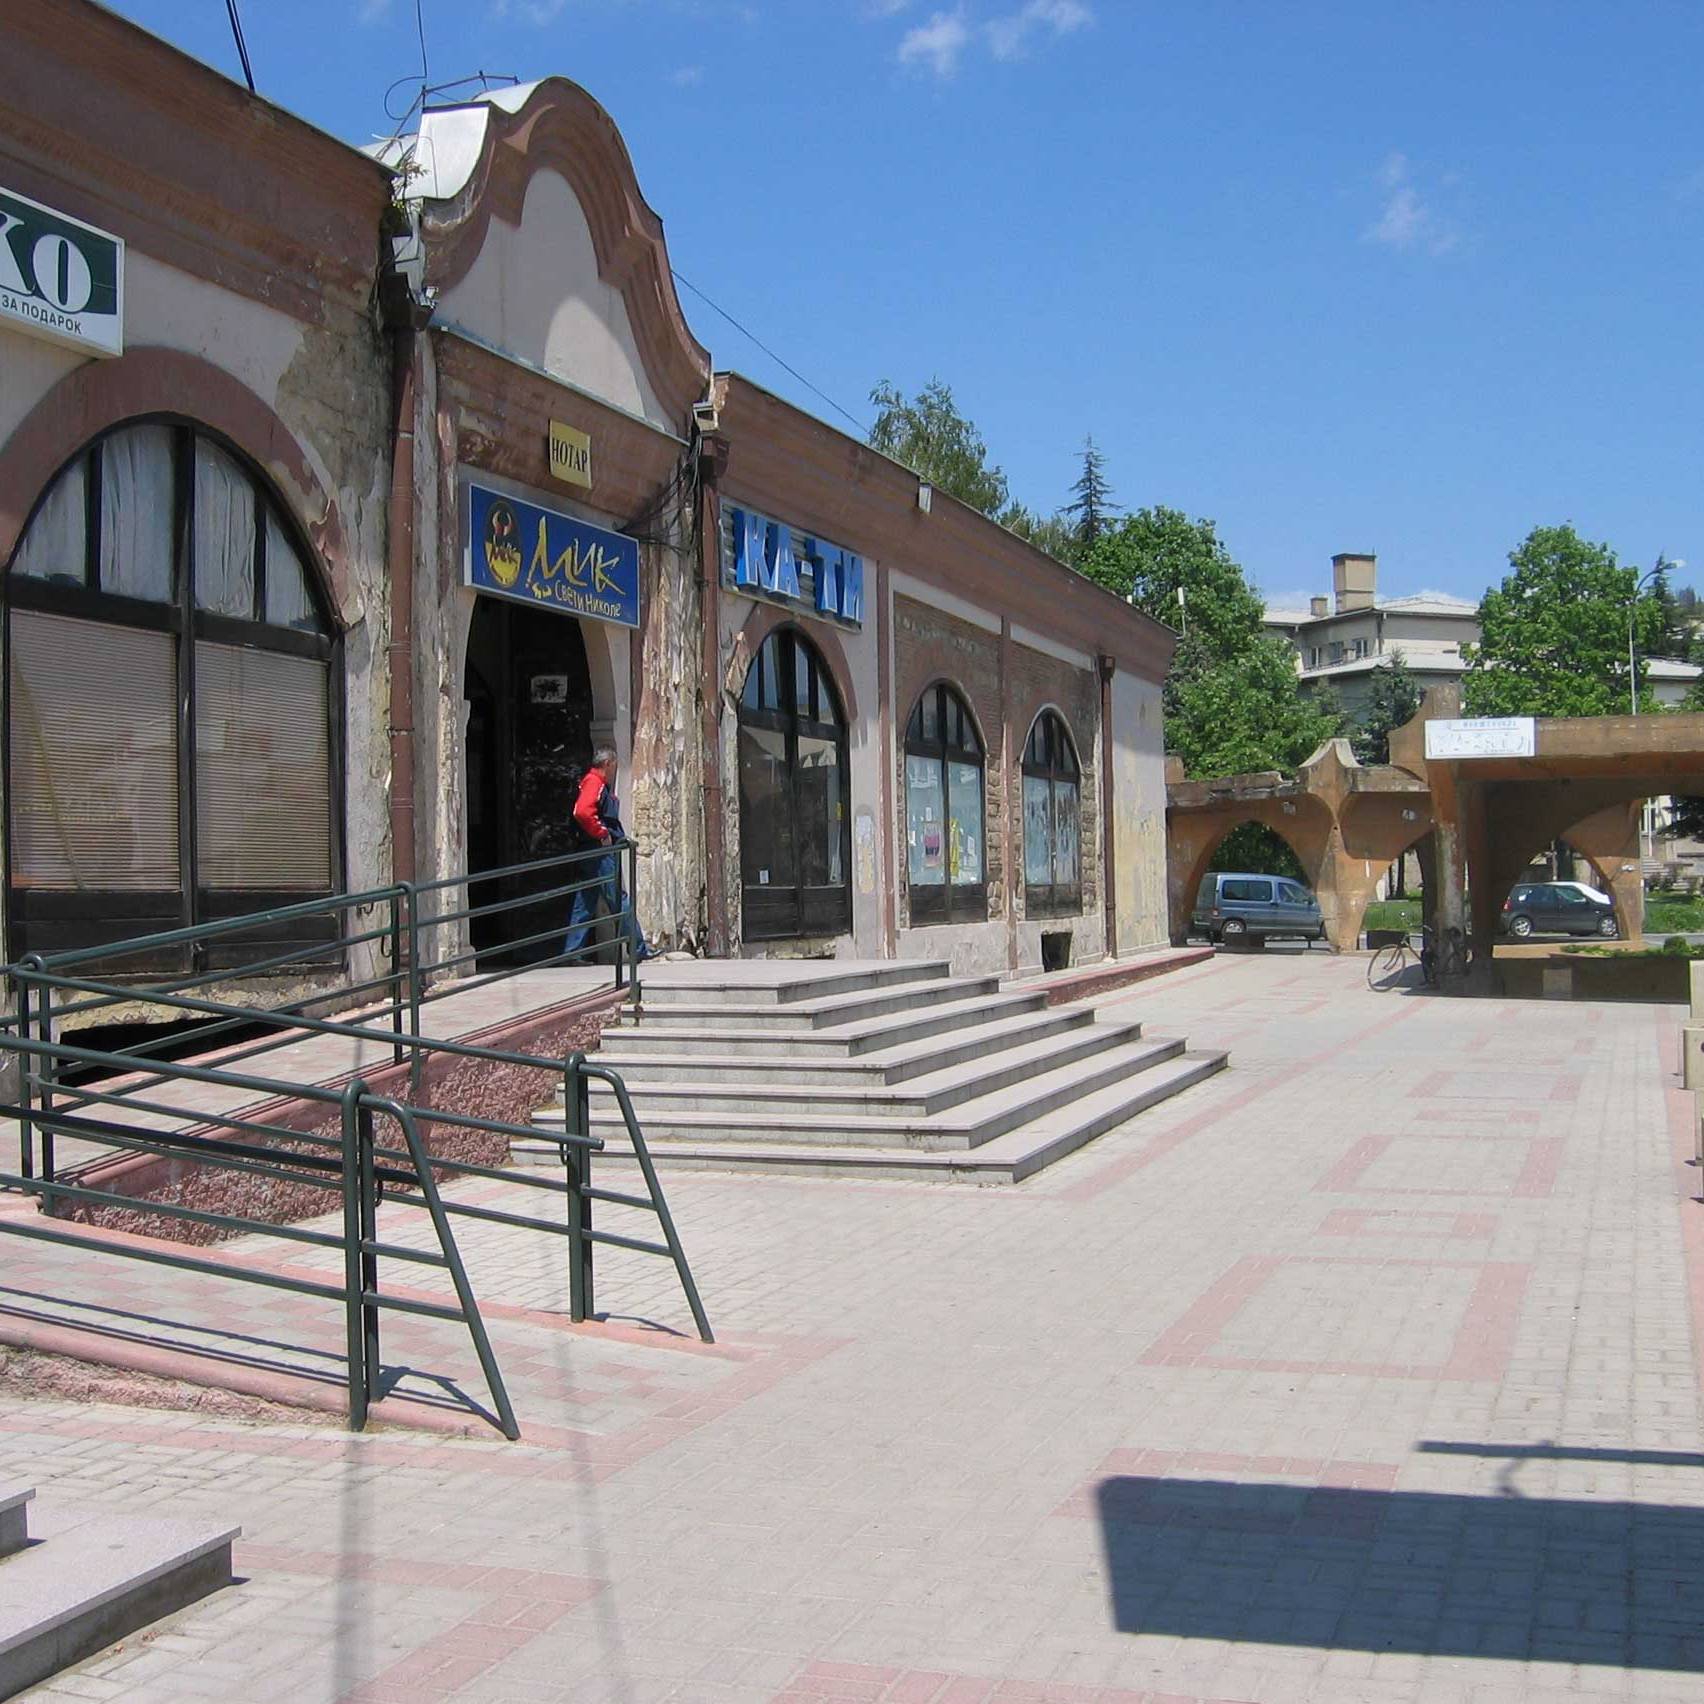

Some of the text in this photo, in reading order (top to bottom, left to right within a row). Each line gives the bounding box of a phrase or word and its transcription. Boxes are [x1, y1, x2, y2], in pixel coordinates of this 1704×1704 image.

[2, 294, 82, 334] ЗА ПОДАРОК
[551, 438, 588, 472] НОТАР
